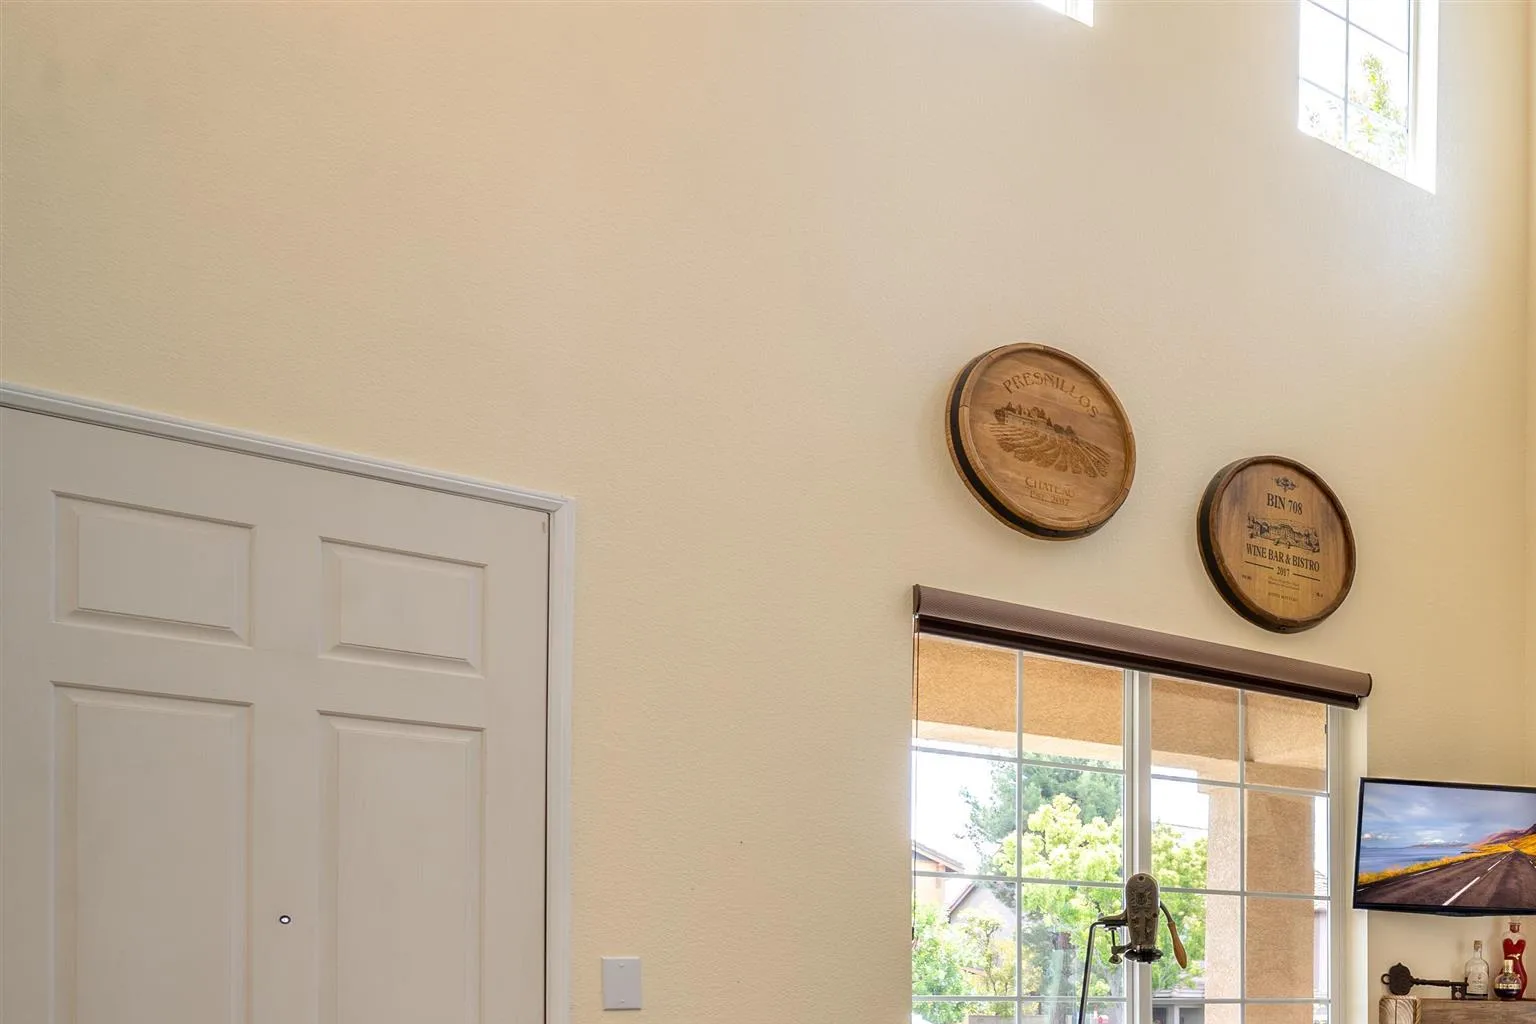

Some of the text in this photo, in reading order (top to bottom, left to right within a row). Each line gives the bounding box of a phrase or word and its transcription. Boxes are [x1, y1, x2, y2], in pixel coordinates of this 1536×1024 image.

[1003, 372, 1099, 418] PRESNILLOS
[1266, 493, 1303, 515] BIN 708
[1246, 543, 1320, 572] WINE BAR & BISTRO
[1276, 566, 1290, 577] 2017
